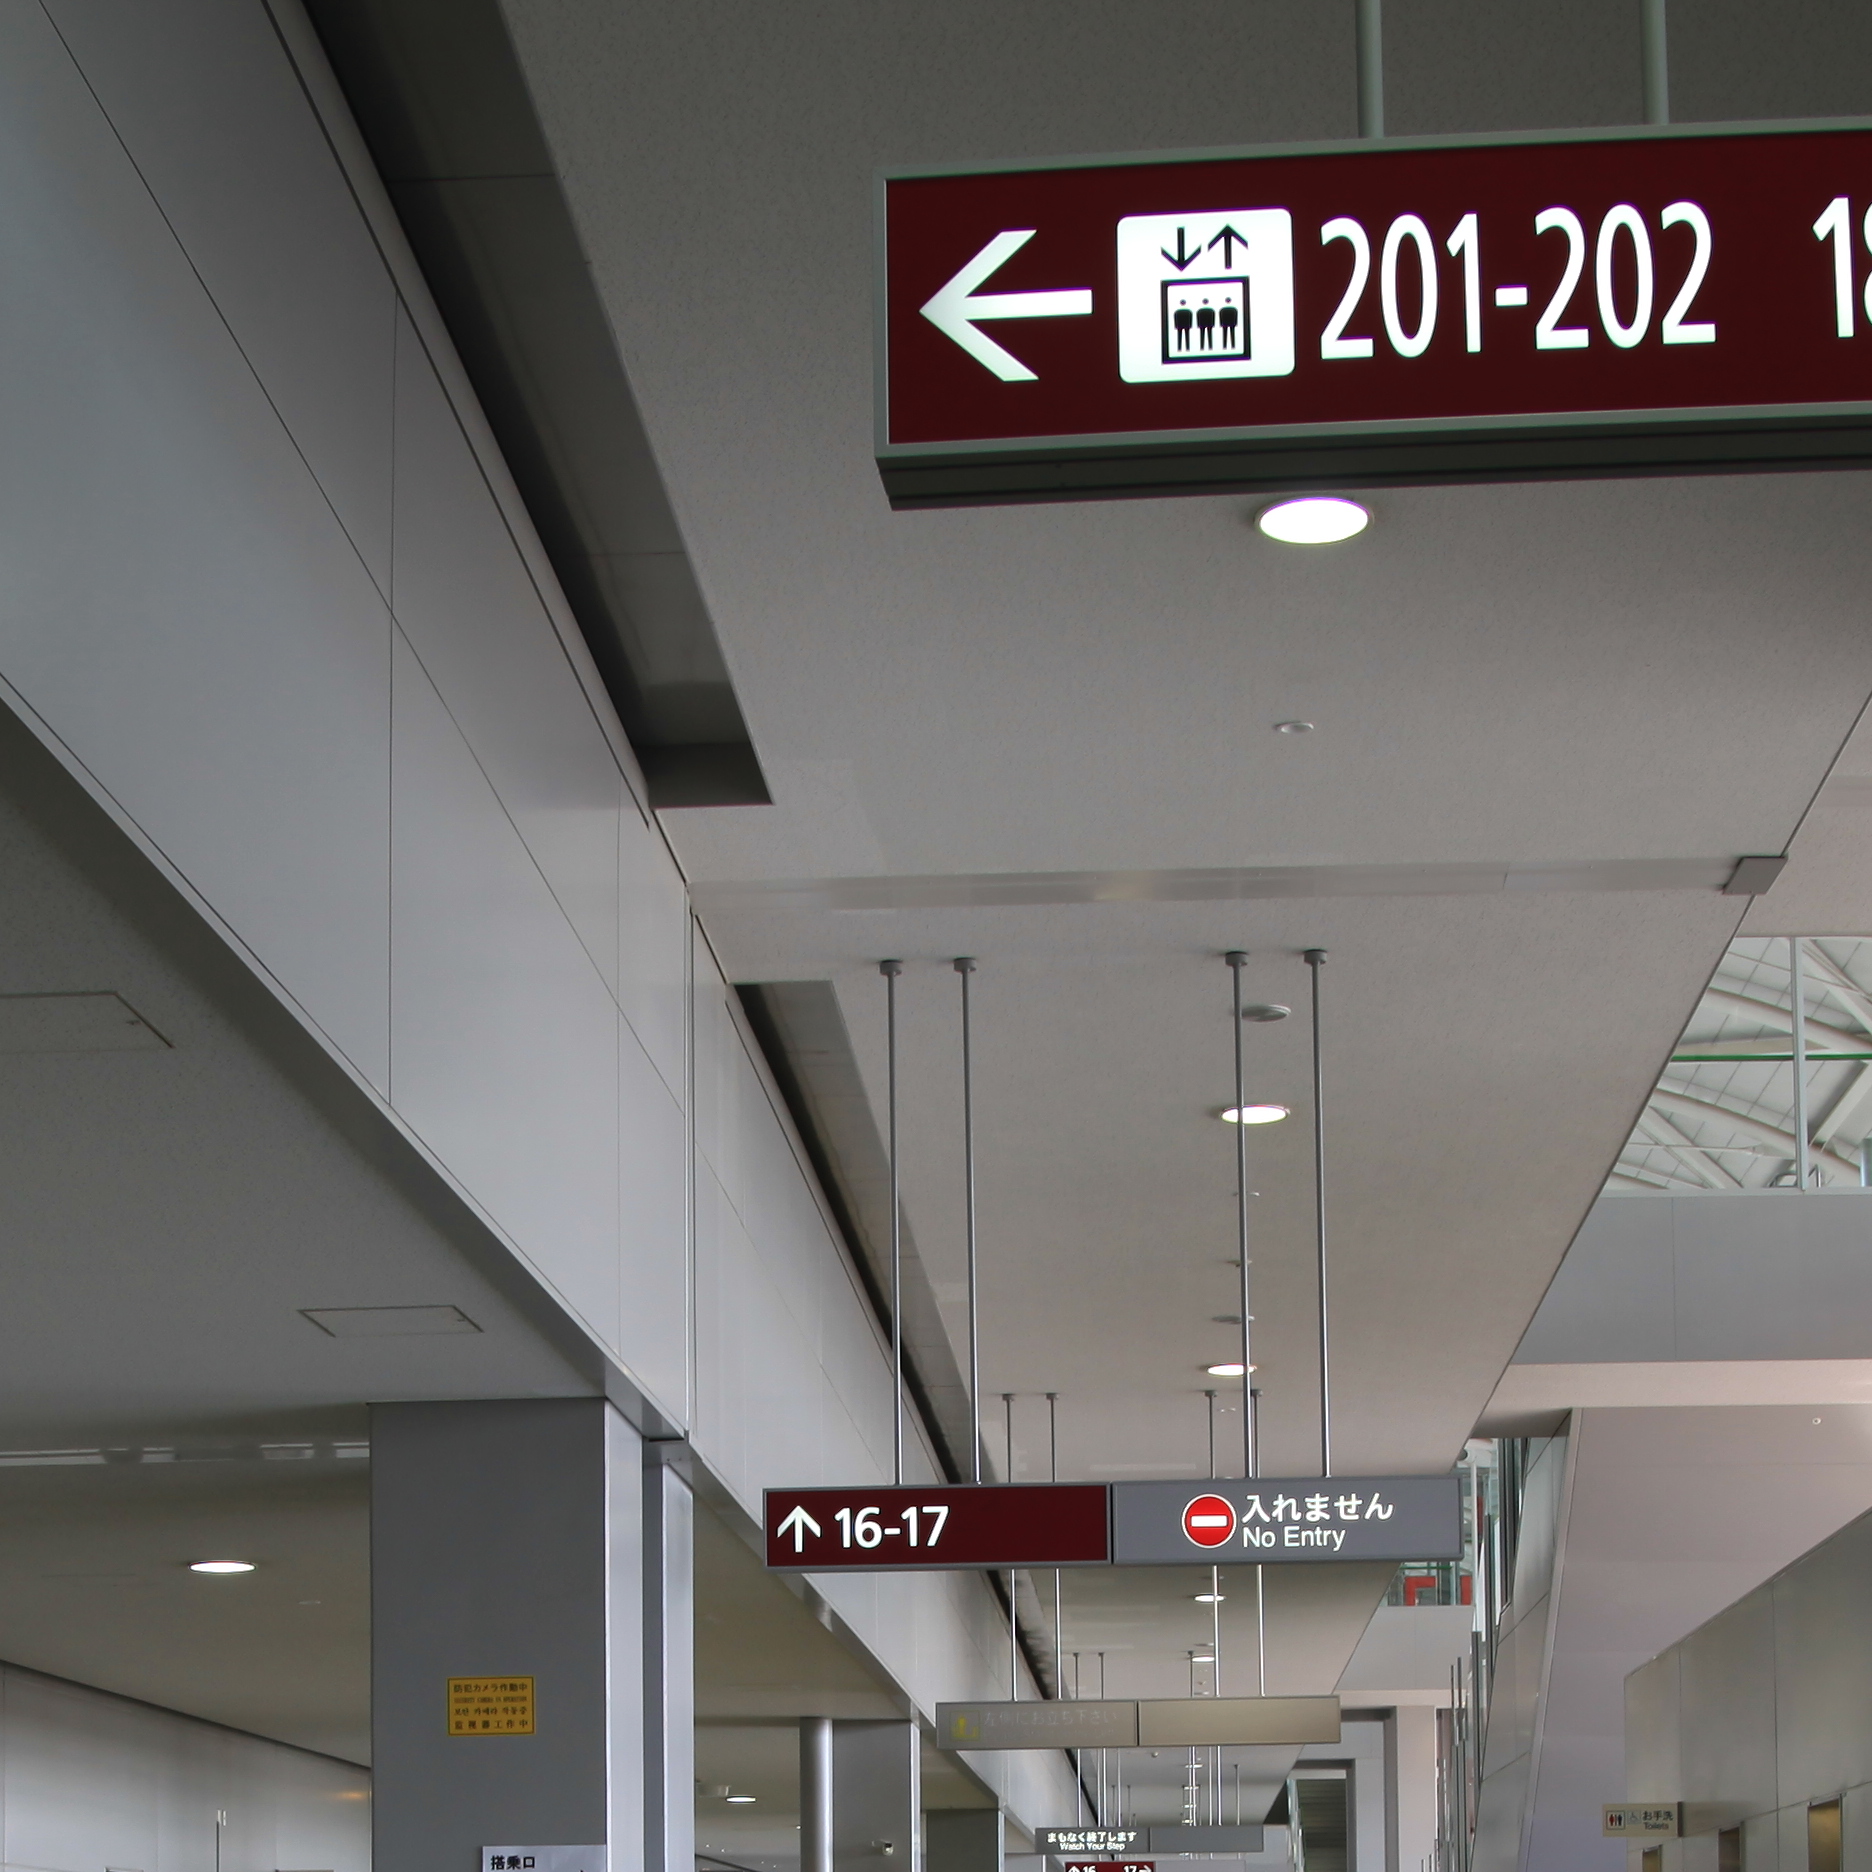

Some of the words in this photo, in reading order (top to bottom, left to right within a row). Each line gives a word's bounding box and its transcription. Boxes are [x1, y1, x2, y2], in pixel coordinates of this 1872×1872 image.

[1320, 201, 1717, 361] 201-202
[1241, 1492, 1395, 1523] 入れません
[834, 1505, 949, 1549] 16-17
[1243, 1526, 1276, 1548] No
[1283, 1525, 1346, 1552] Entry
[453, 1682, 528, 1693] 防犯カメラ作動中
[1642, 1810, 1674, 1821] お手洗
[1643, 1822, 1669, 1831] Toilets
[1046, 1831, 1138, 1843] まもなく終了します
[1059, 1842, 1085, 1851] Watch
[1087, 1842, 1106, 1851] Your
[1106, 1842, 1126, 1852] Step
[490, 1855, 536, 1871] 搭乗口
